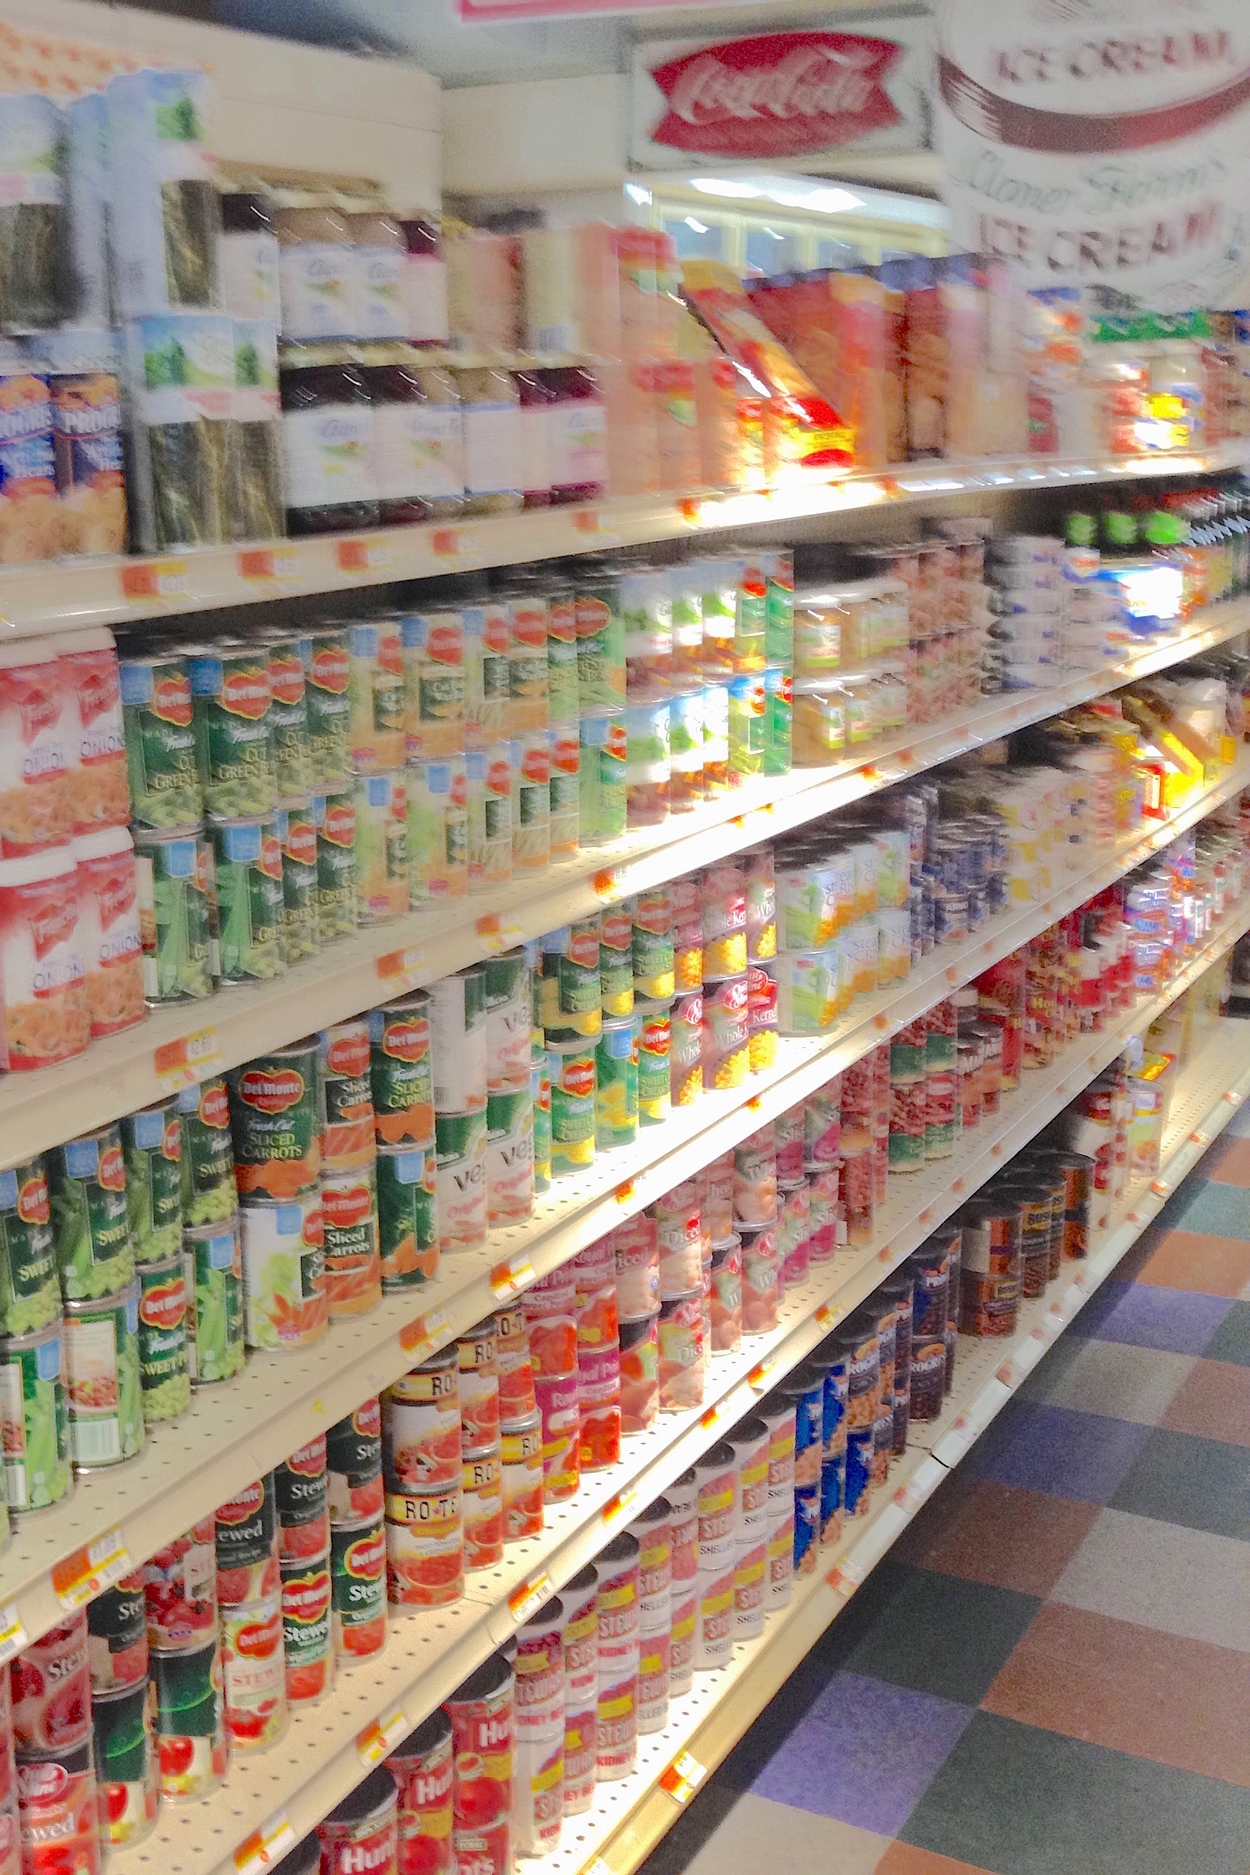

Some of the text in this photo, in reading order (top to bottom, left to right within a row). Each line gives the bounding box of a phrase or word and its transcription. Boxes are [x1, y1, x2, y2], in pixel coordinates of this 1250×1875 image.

[244, 1081, 299, 1095] Del Monte
[249, 1133, 296, 1147] SLICED
[241, 1144, 303, 1159] CARROTS
[326, 1229, 367, 1246] Sliced
